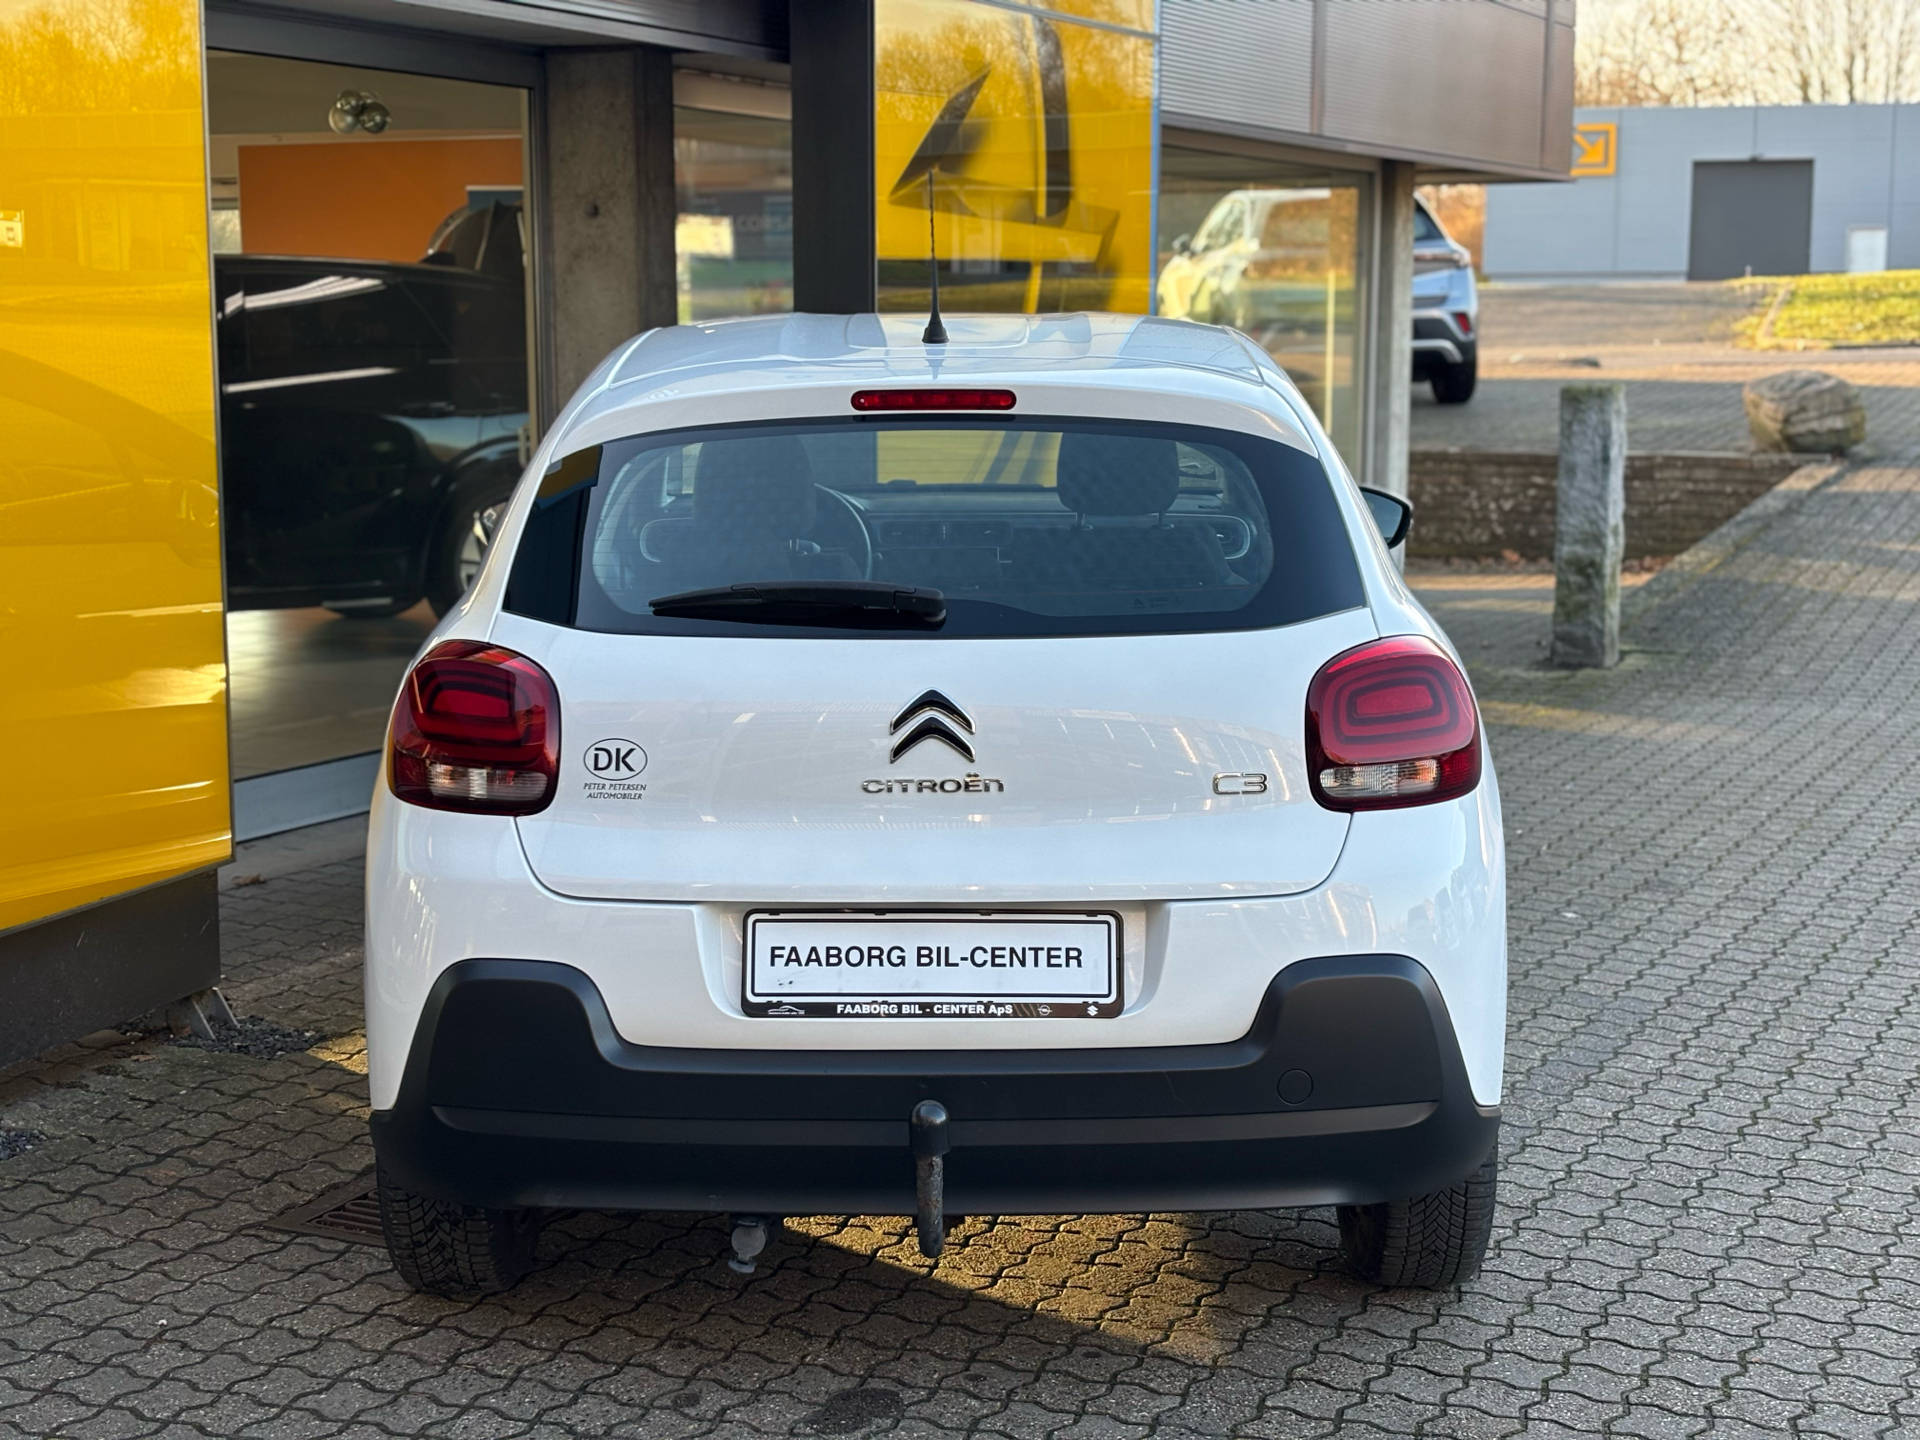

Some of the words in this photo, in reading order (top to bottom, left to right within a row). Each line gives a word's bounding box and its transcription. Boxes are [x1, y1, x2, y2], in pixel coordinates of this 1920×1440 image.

[593, 747, 637, 772] DK
[1212, 772, 1268, 795] C3
[586, 792, 643, 800] AUTOMOBILER
[770, 945, 906, 968] FAABORG
[916, 945, 1084, 968] BIL-CENTER
[836, 1004, 898, 1015] FAABORG
[901, 1004, 923, 1015] BIL
[933, 1004, 985, 1014] CENTER
[988, 1004, 1013, 1016] ApS
